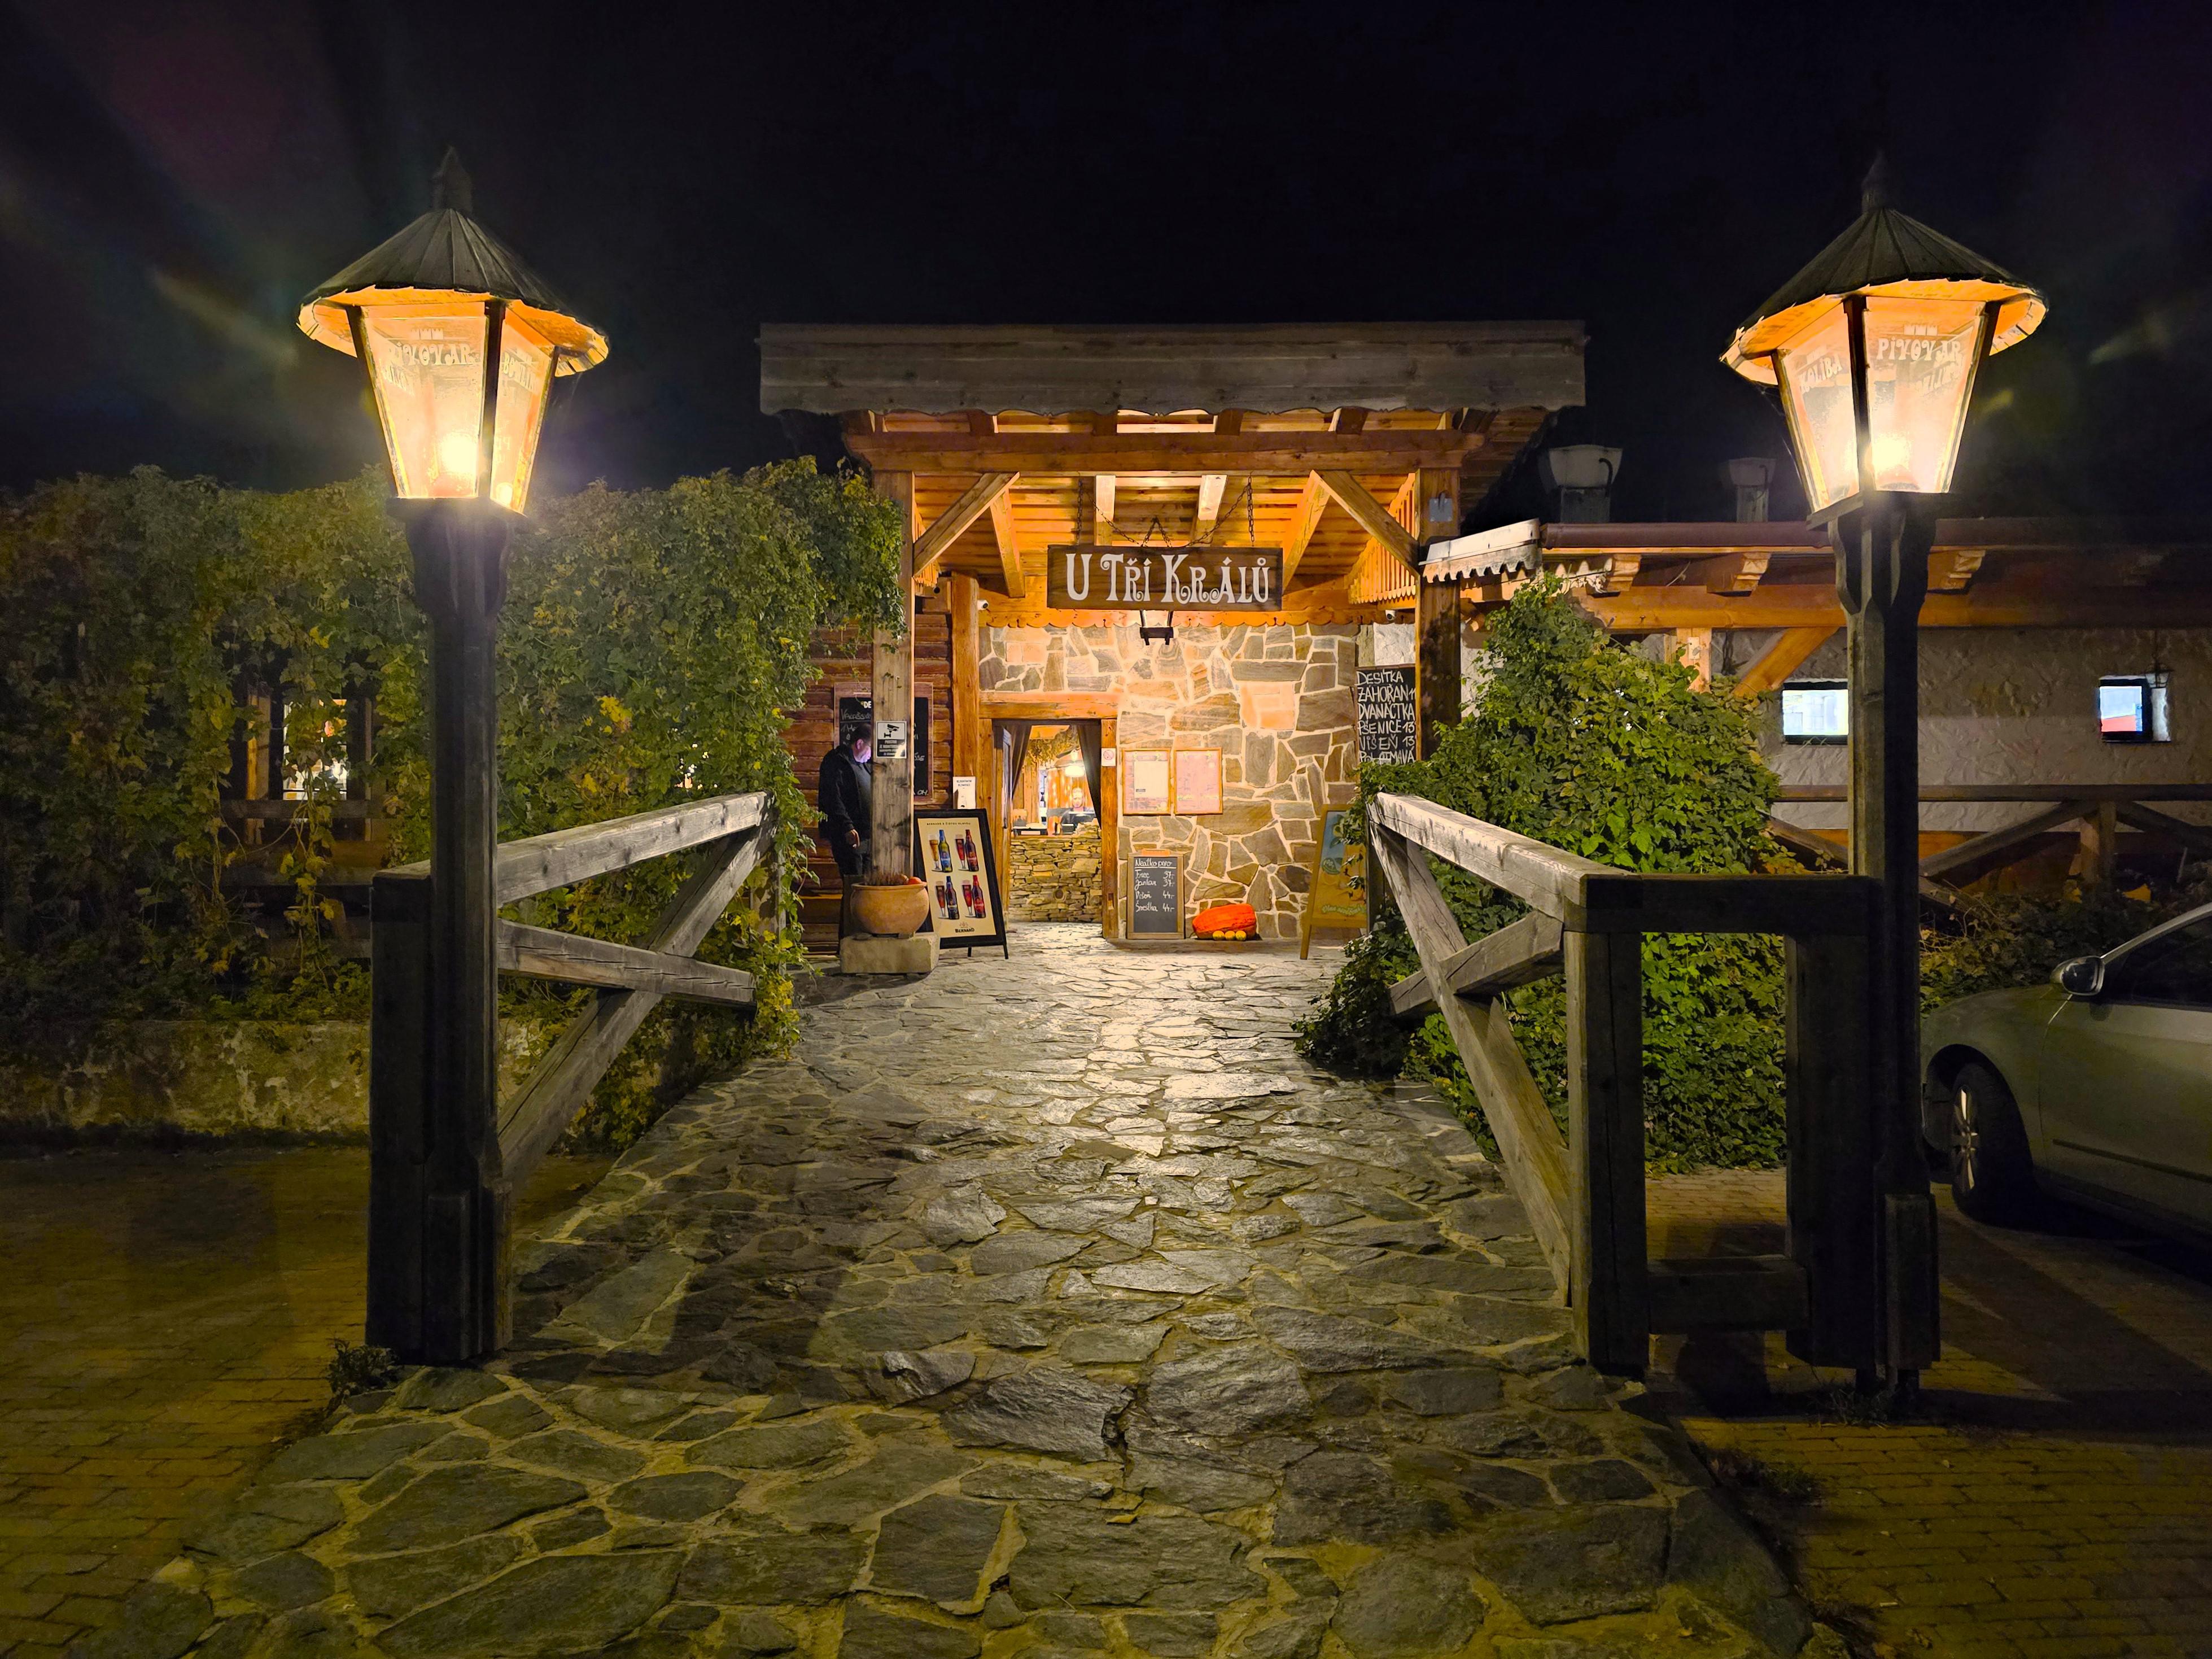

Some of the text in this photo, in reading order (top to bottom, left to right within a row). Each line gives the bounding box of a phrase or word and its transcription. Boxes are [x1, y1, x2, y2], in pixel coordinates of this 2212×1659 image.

[1066, 553, 1092, 601] U
[1357, 701, 1415, 721] DVANÁCTKA
[1356, 719, 1402, 735] PŠENICE
